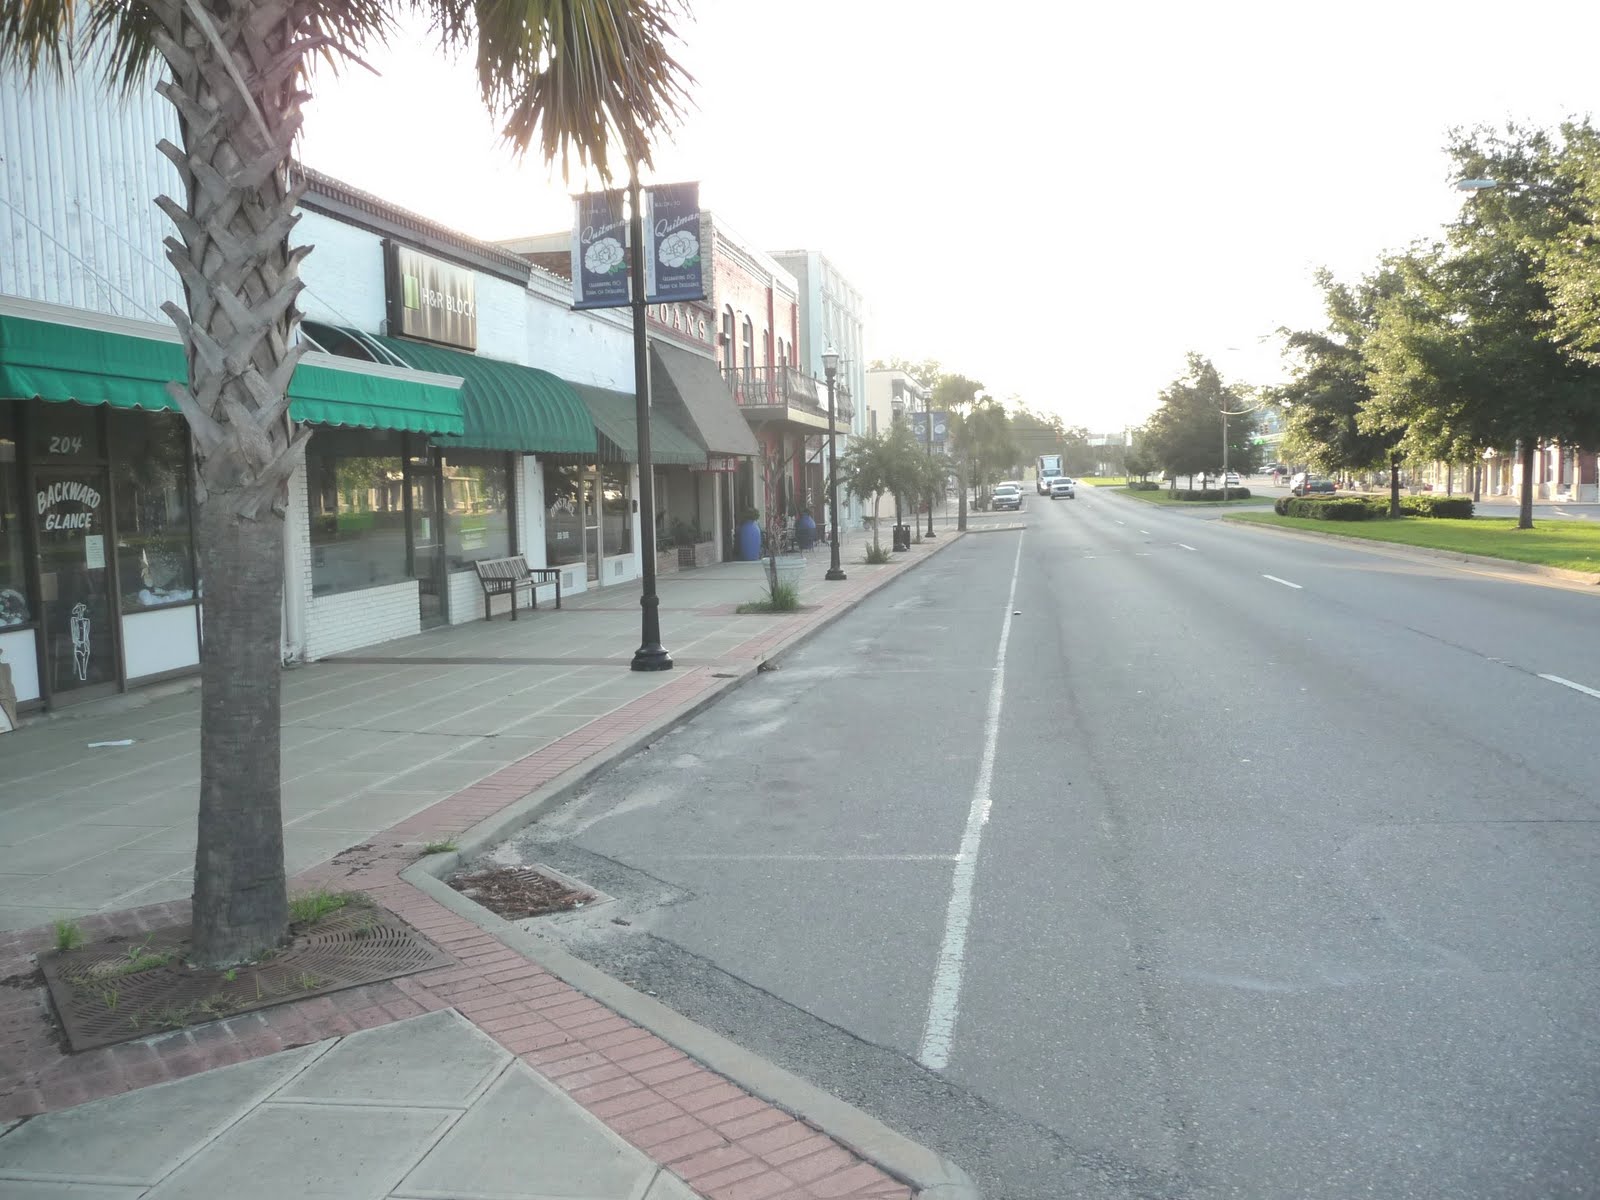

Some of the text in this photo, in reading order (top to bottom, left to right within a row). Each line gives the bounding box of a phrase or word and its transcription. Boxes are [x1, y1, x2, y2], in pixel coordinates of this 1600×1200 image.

[655, 212, 700, 237] Quitman
[421, 288, 475, 318] H&R BLOCK
[648, 303, 705, 340] LOANS
[49, 436, 82, 453] 204
[37, 481, 101, 515] BACKWARD
[45, 512, 92, 530] GLANCE
